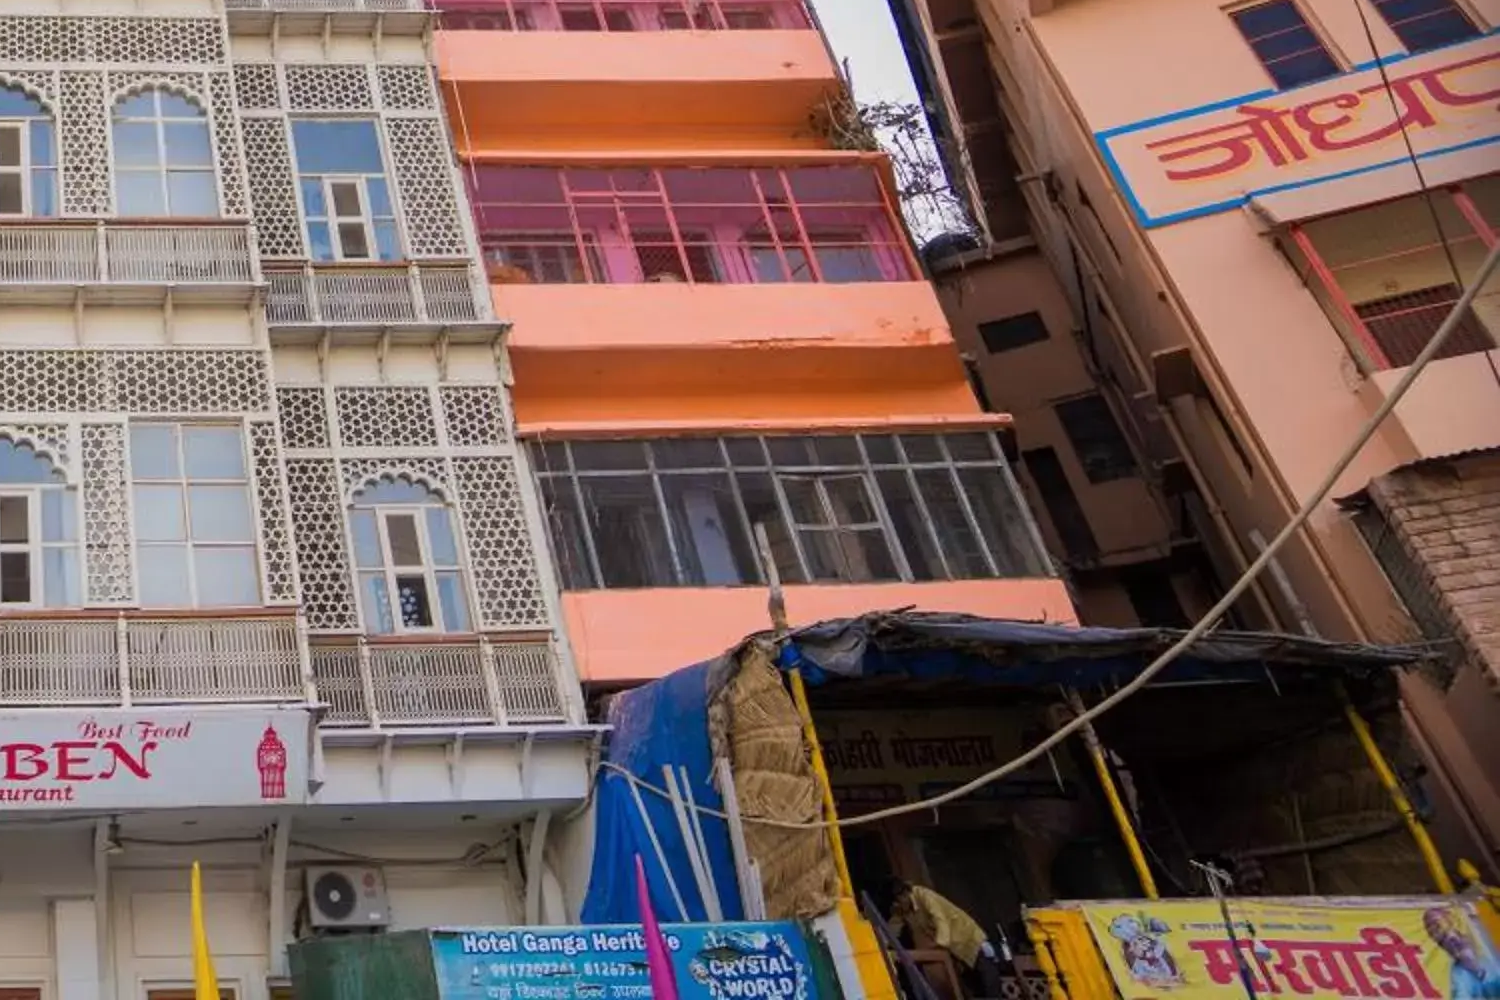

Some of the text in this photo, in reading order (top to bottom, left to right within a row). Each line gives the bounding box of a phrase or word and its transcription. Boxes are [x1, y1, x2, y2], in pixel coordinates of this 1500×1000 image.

[78, 717, 192, 743] Best Food
[461, 931, 681, 956] Hotel Ganga Herite
[709, 955, 794, 977] CRYSTAL
[724, 976, 795, 998] WORLD
